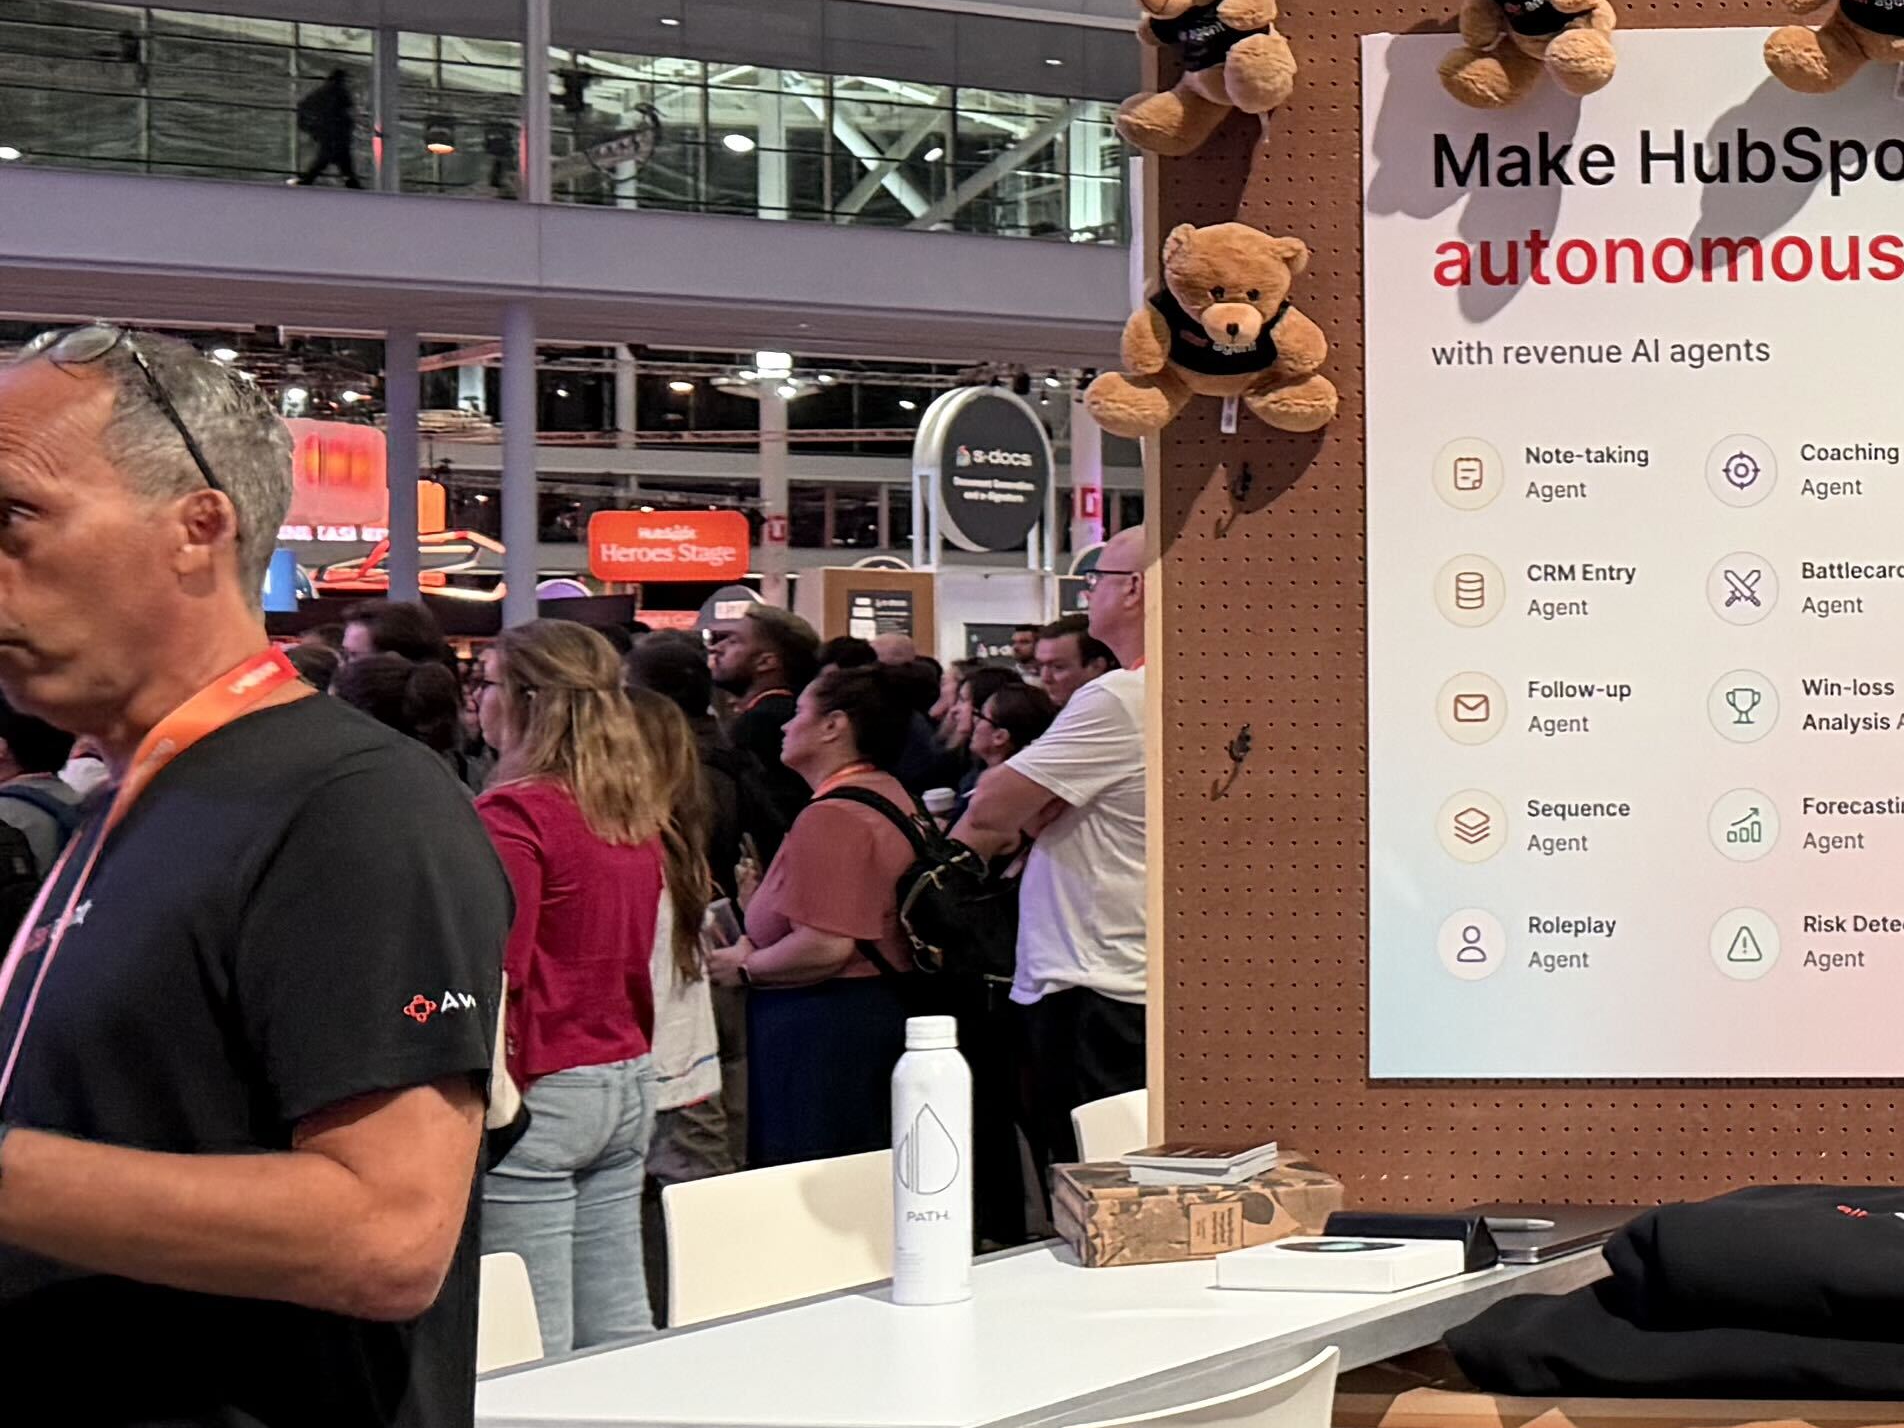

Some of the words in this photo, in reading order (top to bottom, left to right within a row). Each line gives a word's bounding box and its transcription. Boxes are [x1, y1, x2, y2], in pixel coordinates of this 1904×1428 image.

[1433, 130, 1616, 188] Make
[1432, 341, 1492, 365] with
[1504, 345, 1622, 364] revenue
[1632, 339, 1659, 362] AI
[1671, 340, 1770, 369] agents
[972, 449, 1032, 467] s-docs
[1526, 446, 1648, 467] Note-taking
[1801, 443, 1899, 464] Coaching
[1526, 482, 1586, 502] Agent
[1801, 479, 1862, 500] Agent
[600, 543, 674, 562] Heroes
[677, 543, 737, 567] Stage
[1527, 564, 1575, 581] CRM
[1583, 564, 1636, 584] Entry
[1528, 600, 1588, 620] Agent
[1802, 597, 1863, 618] Agent
[1529, 681, 1631, 702] Follow-up
[1802, 678, 1894, 696] Win-loss
[1528, 716, 1589, 736] Agent
[1803, 712, 1890, 734] Analysis
[1528, 800, 1630, 820] Sequence
[1528, 835, 1588, 856] Agent
[1803, 832, 1864, 854] Agent
[1529, 916, 1616, 937] Roleplay
[1804, 915, 1846, 932] Risk
[1528, 951, 1589, 972] Agent
[1803, 950, 1864, 972] Agent
